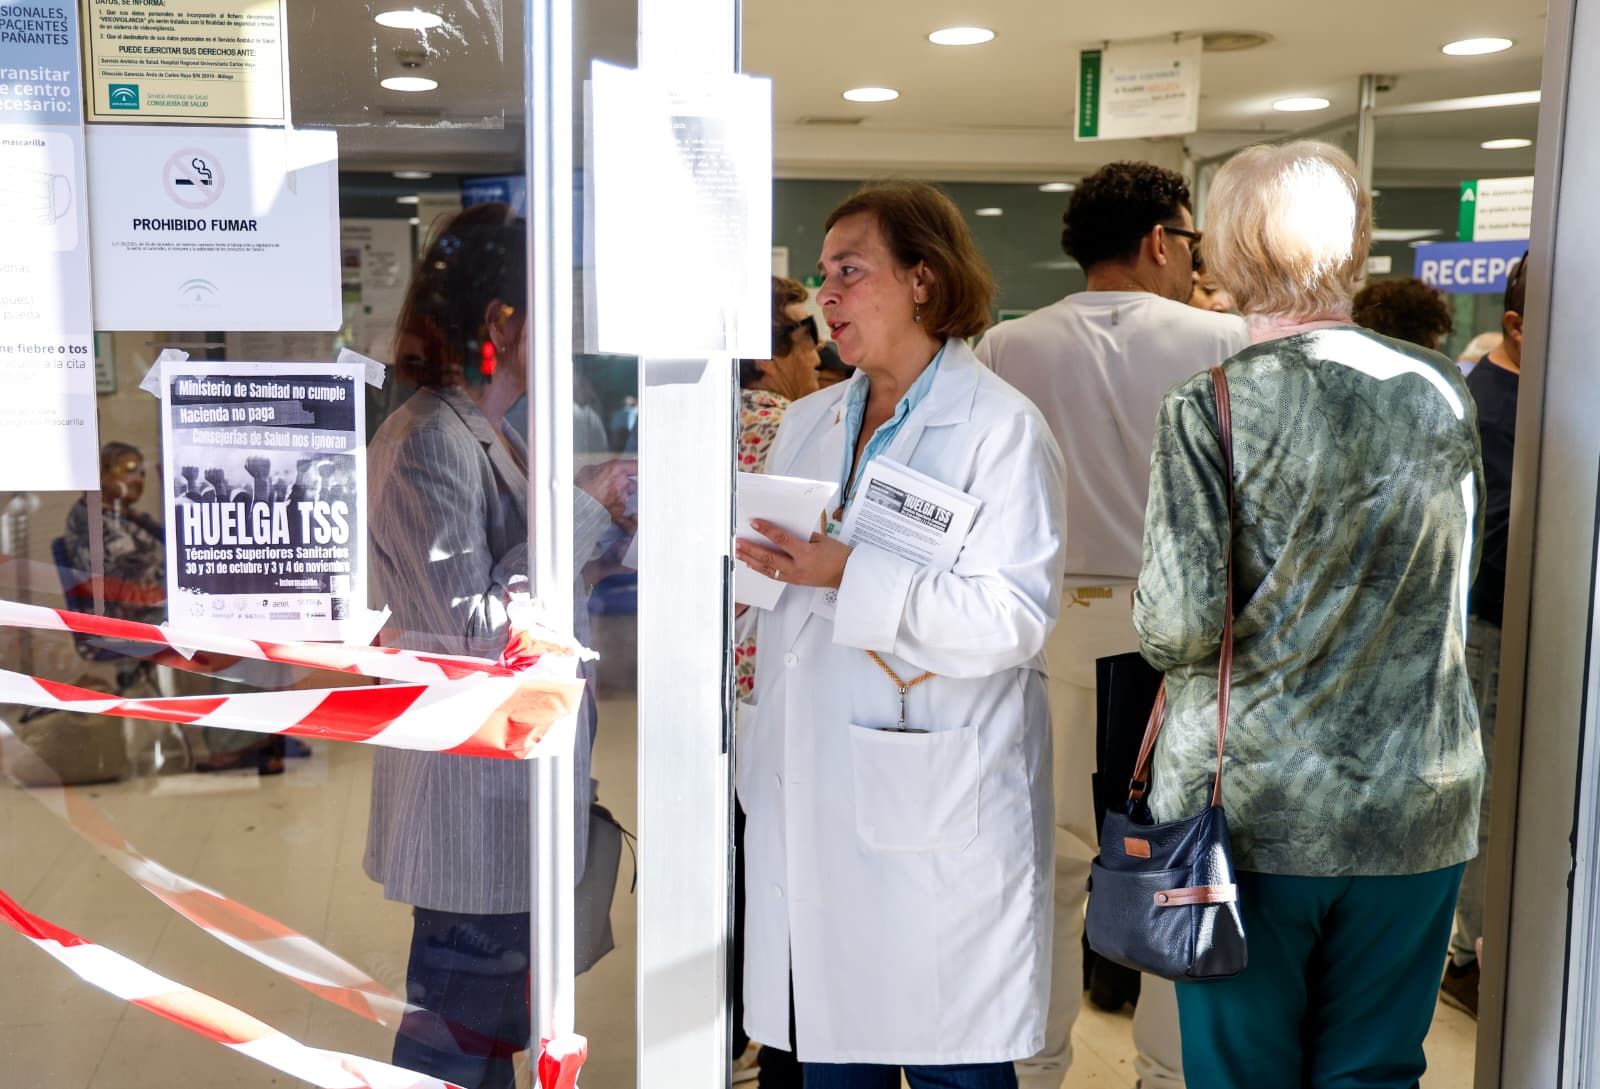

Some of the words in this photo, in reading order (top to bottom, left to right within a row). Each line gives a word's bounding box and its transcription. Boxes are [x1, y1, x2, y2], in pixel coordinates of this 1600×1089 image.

[0, 18, 68, 32] PACIENTES
[1, 30, 69, 45] PAÑANTES
[118, 45, 142, 54] PUEDE
[143, 46, 181, 55] EJERCITAR
[182, 47, 197, 55] SUS
[197, 47, 237, 56] DERECHOS
[0, 66, 70, 82] ransitar
[14, 83, 71, 97] centro
[2, 138, 46, 147] mascarilla
[133, 218, 207, 231] PROHIBIDO
[211, 219, 257, 232] FUMAR
[17, 343, 55, 354] fiebre
[57, 345, 66, 354] o
[68, 344, 89, 355] tos
[53, 359, 63, 369] la
[65, 358, 87, 369] cita
[178, 380, 232, 397] Ministerio
[234, 382, 247, 397] de
[250, 383, 291, 399] Sanidad
[292, 385, 305, 399] no
[307, 385, 346, 402] cumple
[180, 406, 230, 423] Hacienda
[232, 408, 246, 421] no
[248, 406, 275, 422] paga
[192, 428, 248, 447] Consejerías
[250, 430, 262, 446] de
[264, 431, 290, 448] Salud
[292, 434, 309, 448] nos
[311, 432, 347, 450] ignoran
[904, 494, 936, 518] HUELGA
[934, 506, 952, 523] TSS
[182, 501, 291, 546] HUELGA
[297, 500, 350, 545] TSS
[185, 547, 234, 560] Técnicos
[236, 546, 294, 560] Superiores
[296, 546, 350, 559] Sanitarios
[185, 563, 197, 575] 30
[198, 565, 204, 576] y
[205, 562, 215, 574] 31
[216, 562, 227, 574] de
[229, 561, 263, 575] octubre
[263, 564, 270, 576] y
[271, 561, 277, 574] 3
[278, 564, 284, 575] y
[286, 561, 292, 573] 4
[293, 561, 304, 573] de
[306, 560, 350, 573] noviembre
